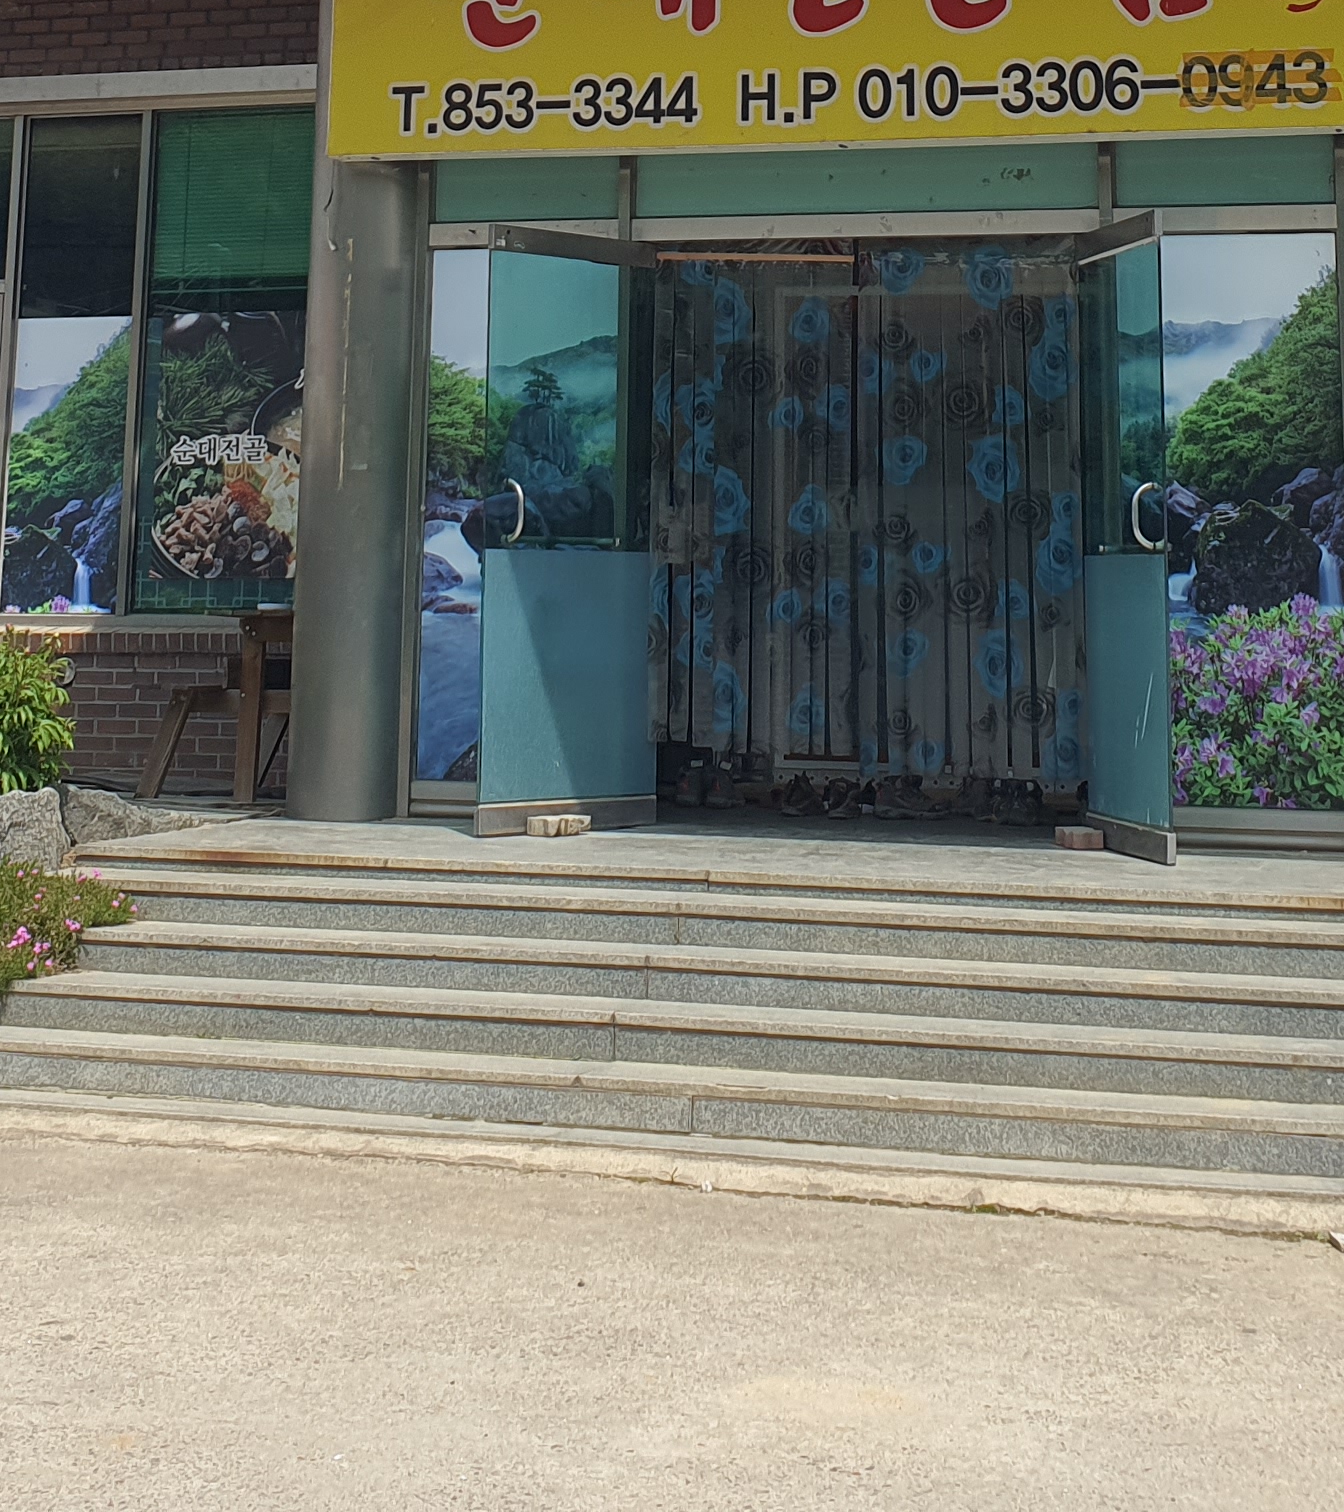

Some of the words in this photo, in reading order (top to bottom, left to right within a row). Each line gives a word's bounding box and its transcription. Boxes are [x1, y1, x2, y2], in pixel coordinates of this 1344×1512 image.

[391, 75, 699, 135] T.853-3344
[739, 70, 837, 124] H.P
[857, 50, 1328, 119] 010-3306-0943
[171, 434, 267, 465] 순대전골
